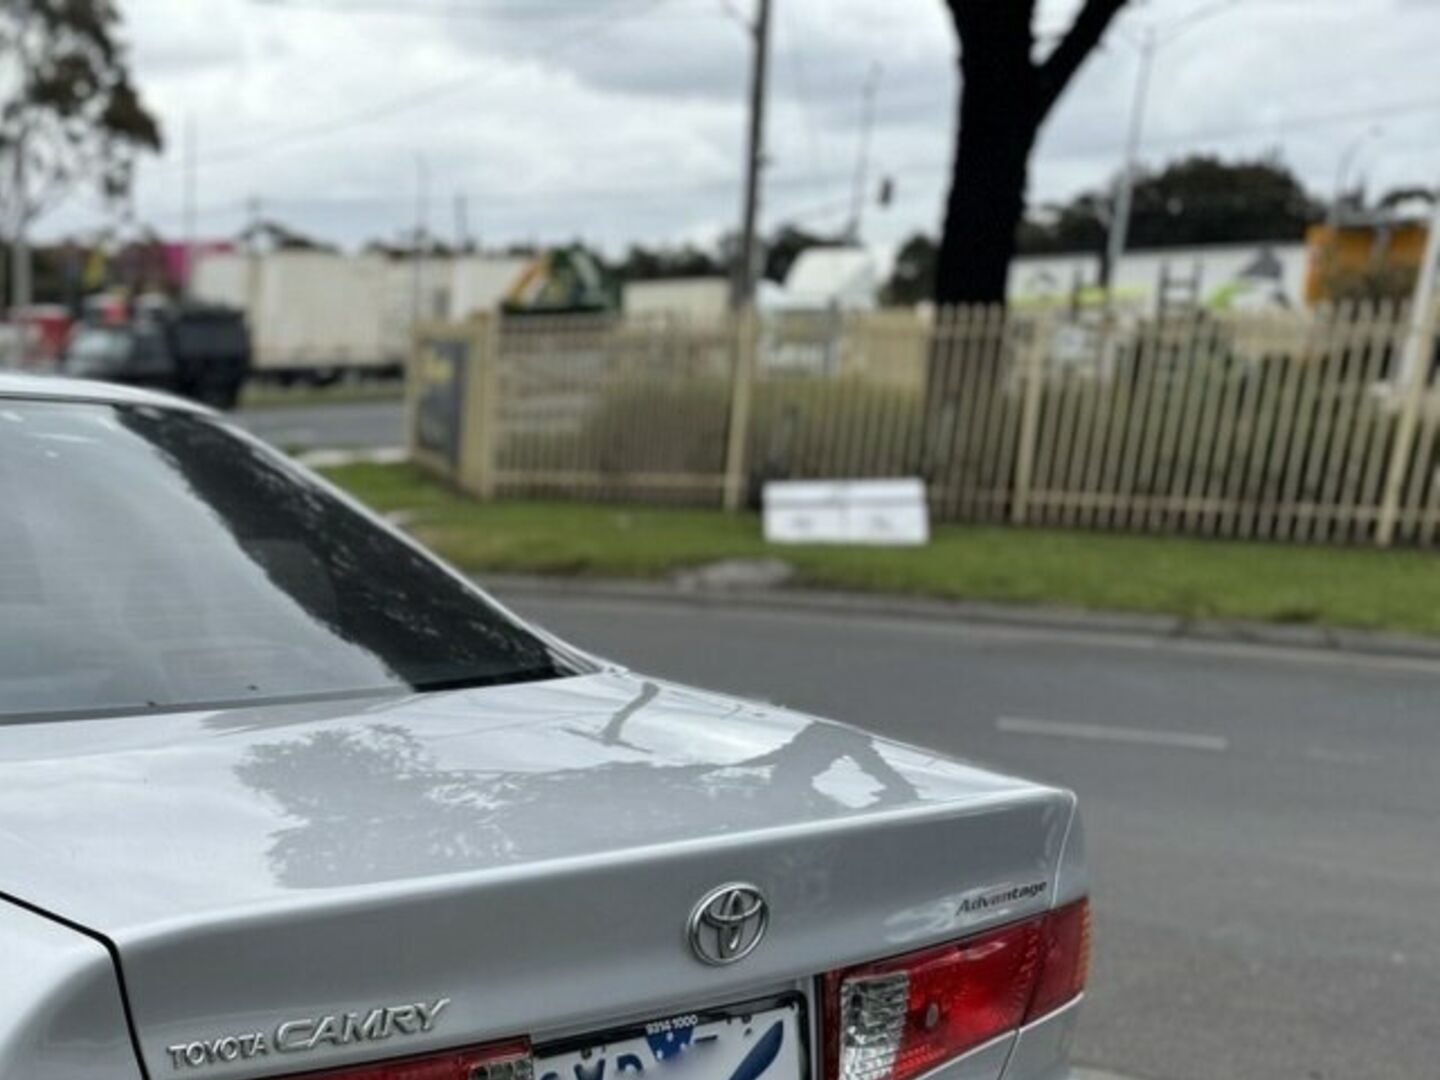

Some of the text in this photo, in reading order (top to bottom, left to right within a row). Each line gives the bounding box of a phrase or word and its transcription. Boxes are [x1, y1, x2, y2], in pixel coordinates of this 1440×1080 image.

[956, 881, 1048, 916] Advantage
[168, 998, 451, 1069] TOYOTA CAMRY
